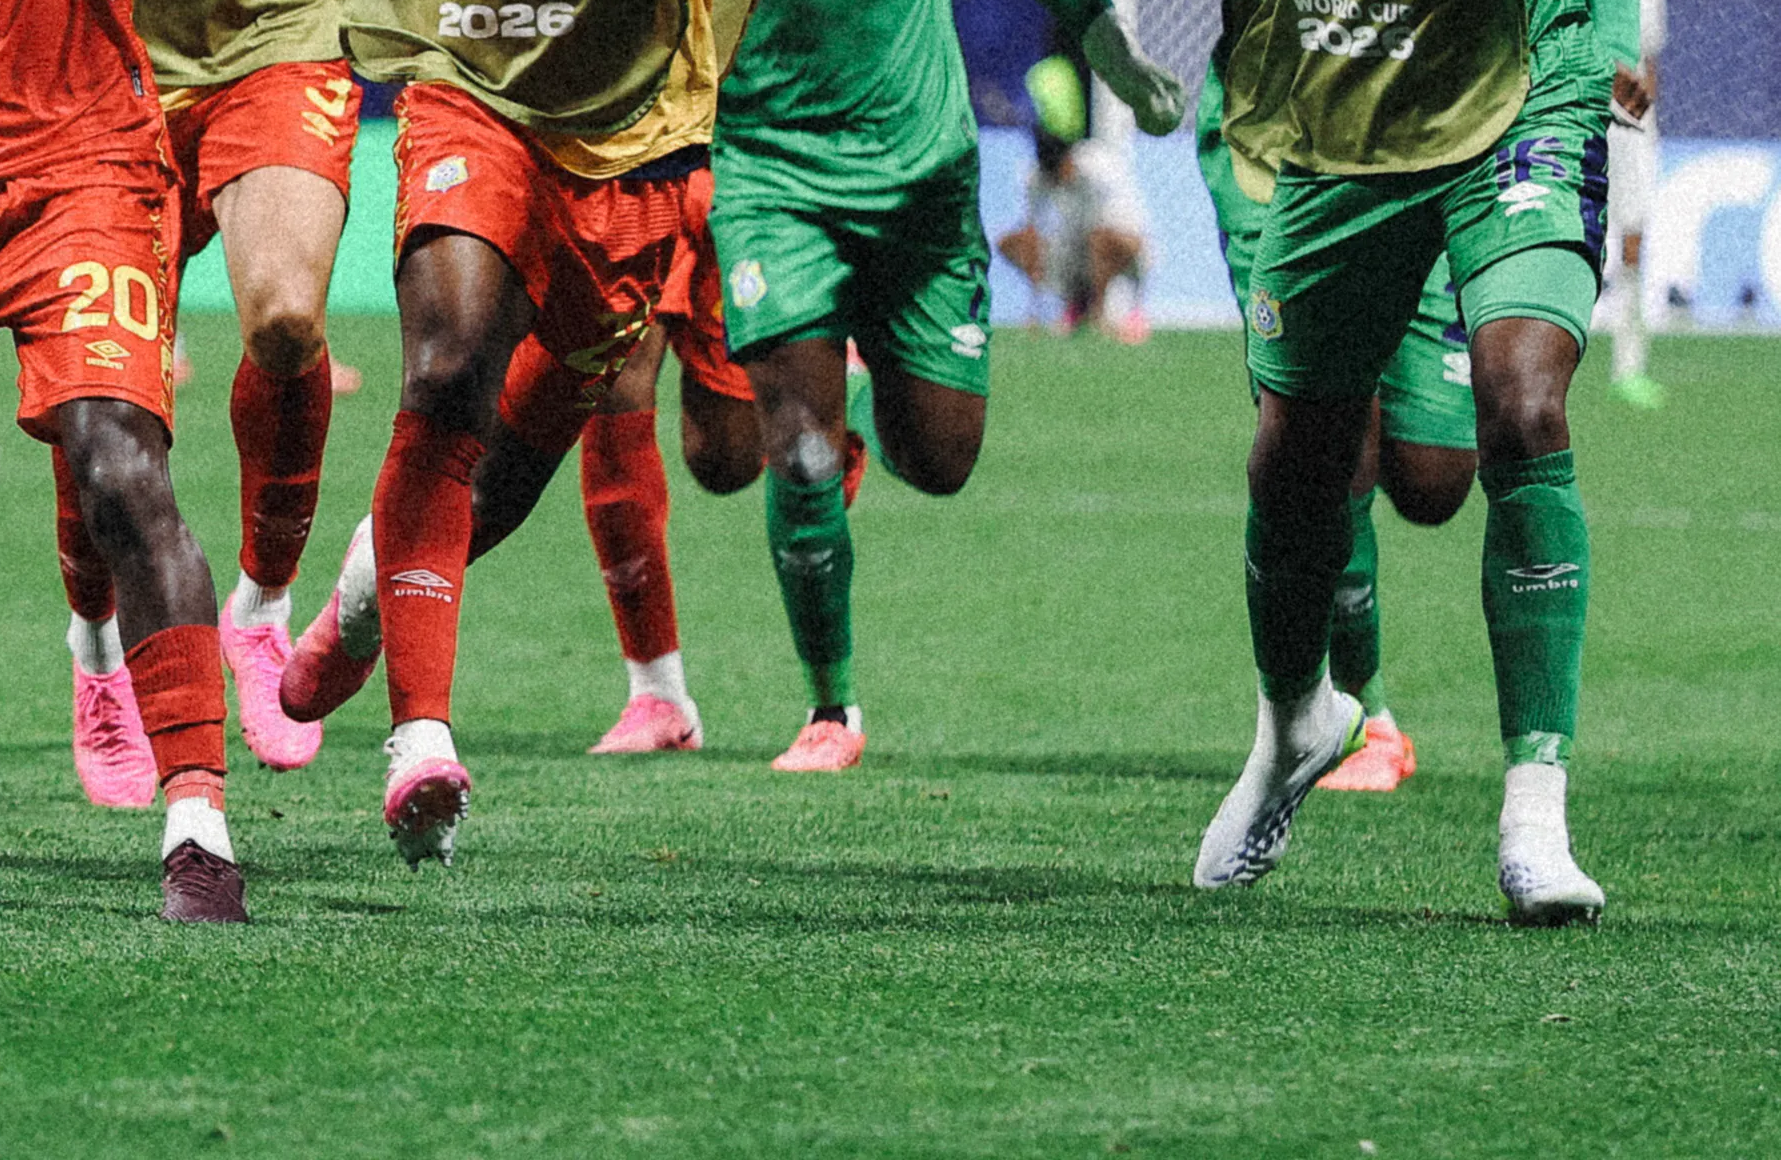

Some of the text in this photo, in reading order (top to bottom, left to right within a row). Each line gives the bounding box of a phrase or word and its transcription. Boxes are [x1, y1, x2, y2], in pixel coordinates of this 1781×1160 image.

[438, 2, 575, 39] 2026
[1297, 17, 1414, 61] 2026
[58, 261, 159, 341] 20
[394, 586, 452, 603] umbro
[1512, 579, 1578, 593] umbro
